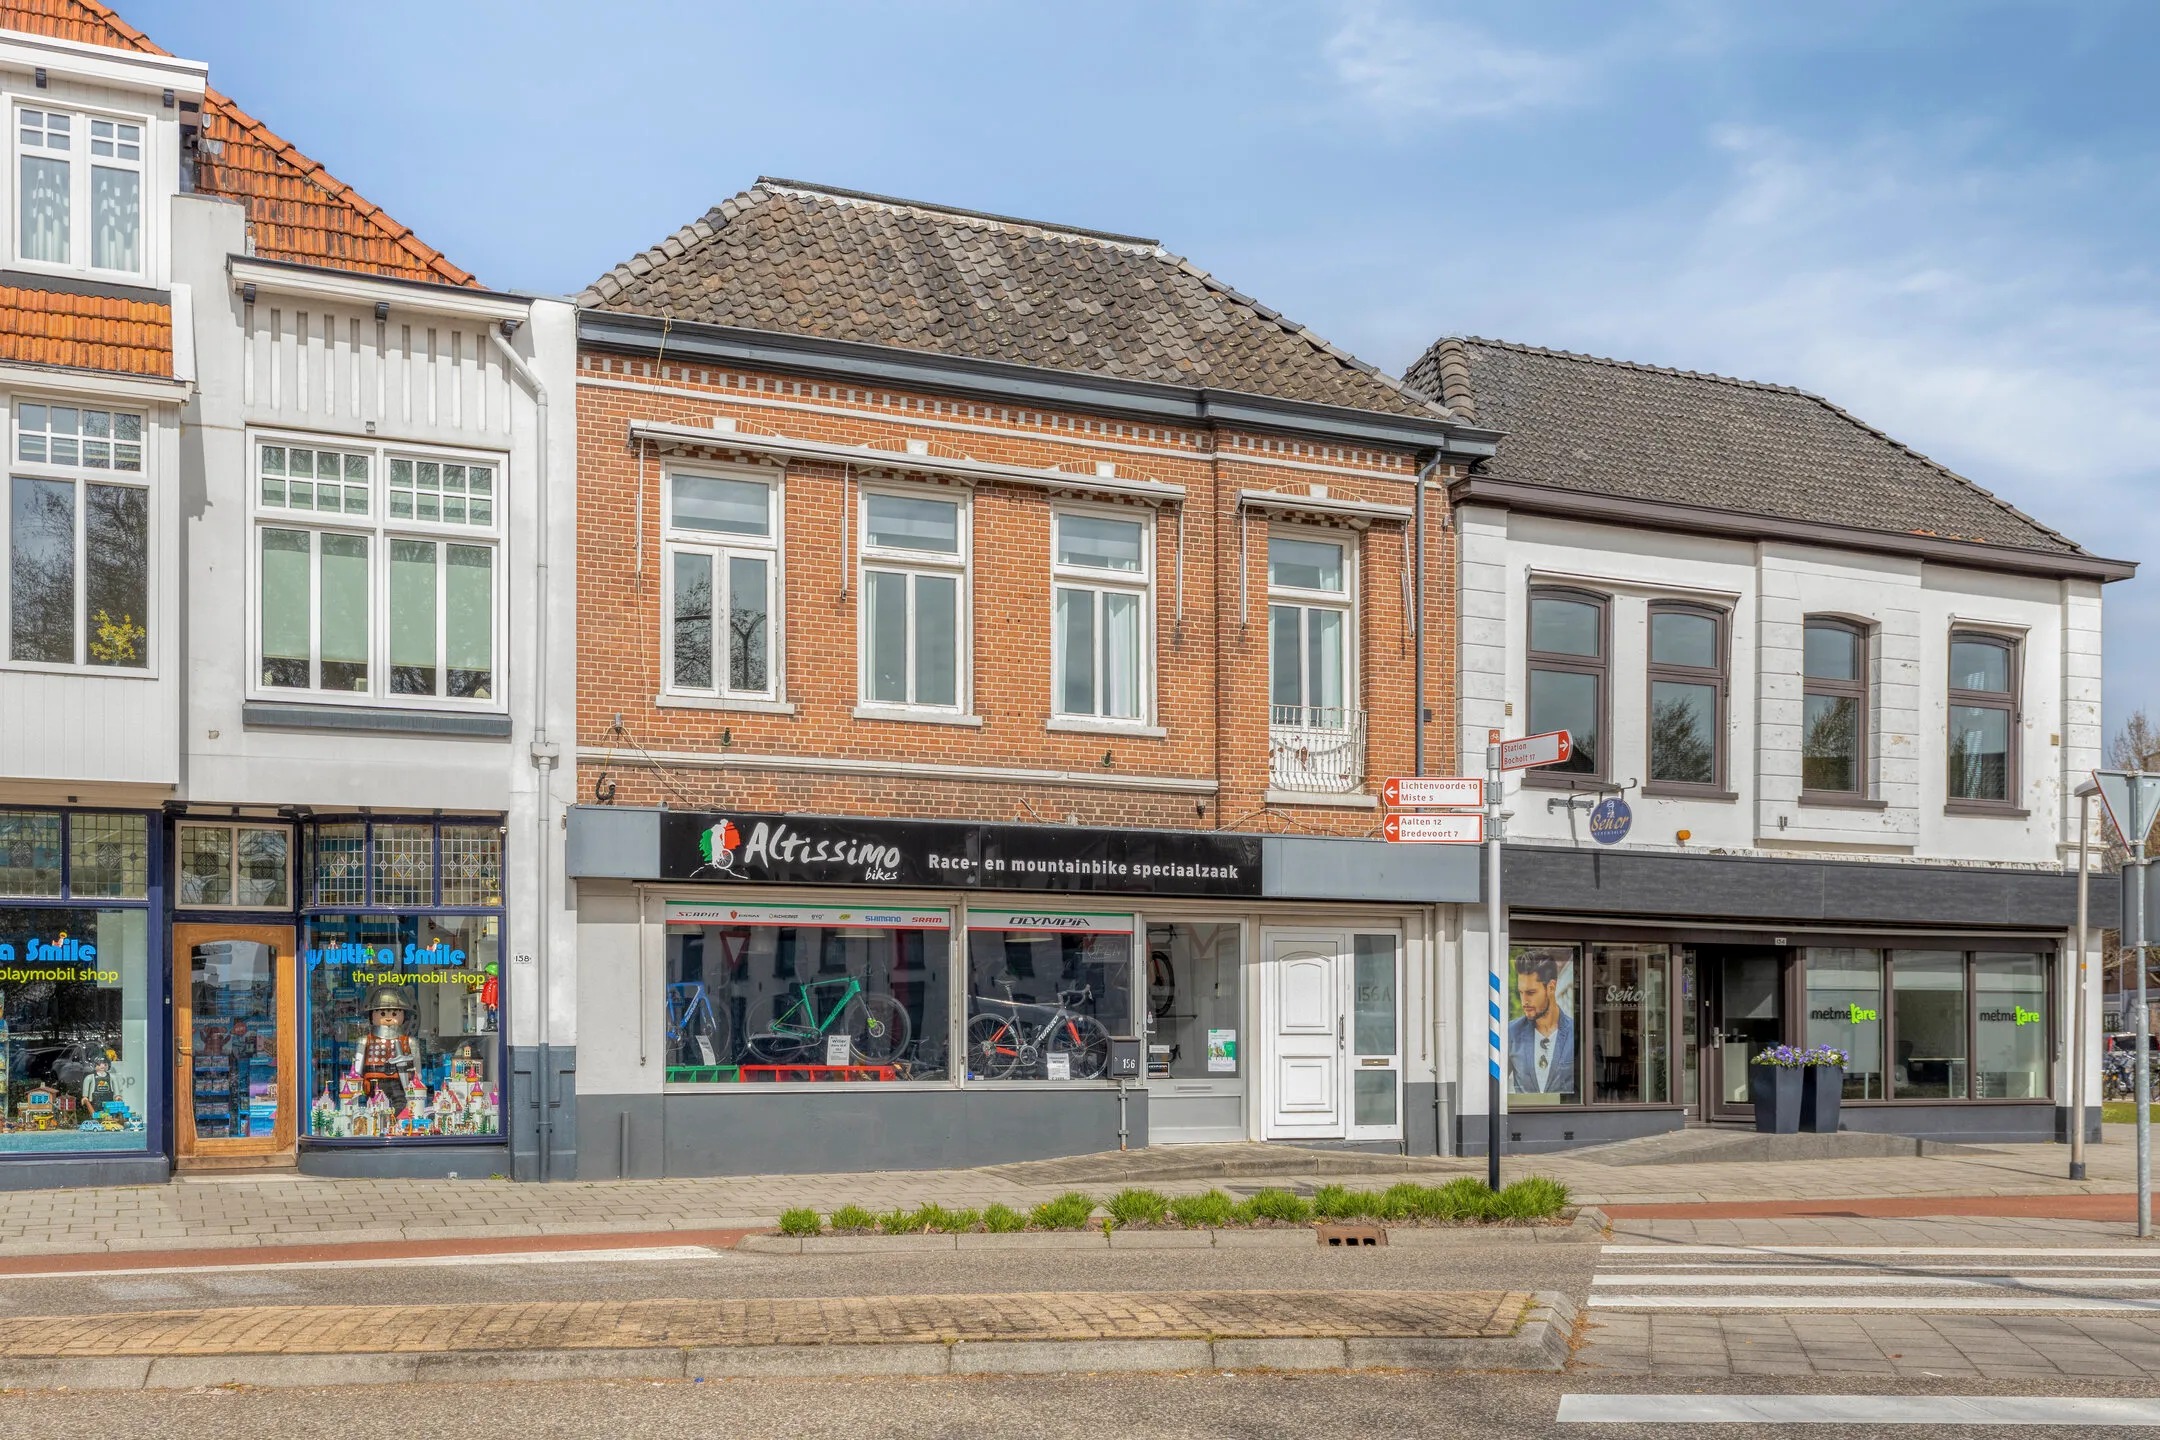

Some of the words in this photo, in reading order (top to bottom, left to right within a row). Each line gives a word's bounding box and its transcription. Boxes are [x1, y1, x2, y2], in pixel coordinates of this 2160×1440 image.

[1504, 743, 1527, 753] Station
[1504, 755, 1528, 765] Bocholt
[1529, 753, 1536, 761] 17
[1401, 782, 1466, 790] Lichtenvoorde
[744, 821, 901, 869] Altissimo
[928, 853, 978, 870] Race-
[984, 857, 1005, 871] en
[1011, 858, 1127, 875] mountainbike
[1132, 862, 1238, 879] speciaalzaak
[865, 867, 898, 881] bikes
[865, 915, 901, 923] SHIMANO
[911, 916, 942, 924] SRAM
[26, 938, 97, 962] Smile
[325, 943, 367, 965] with
[377, 948, 395, 965] a
[404, 943, 466, 966] Smile
[79, 967, 119, 984] shop
[352, 971, 375, 983] the
[378, 971, 448, 985] playmobil
[451, 972, 486, 985] shop
[1606, 984, 1652, 1002] Señor
[1122, 1058, 1136, 1069] 156
